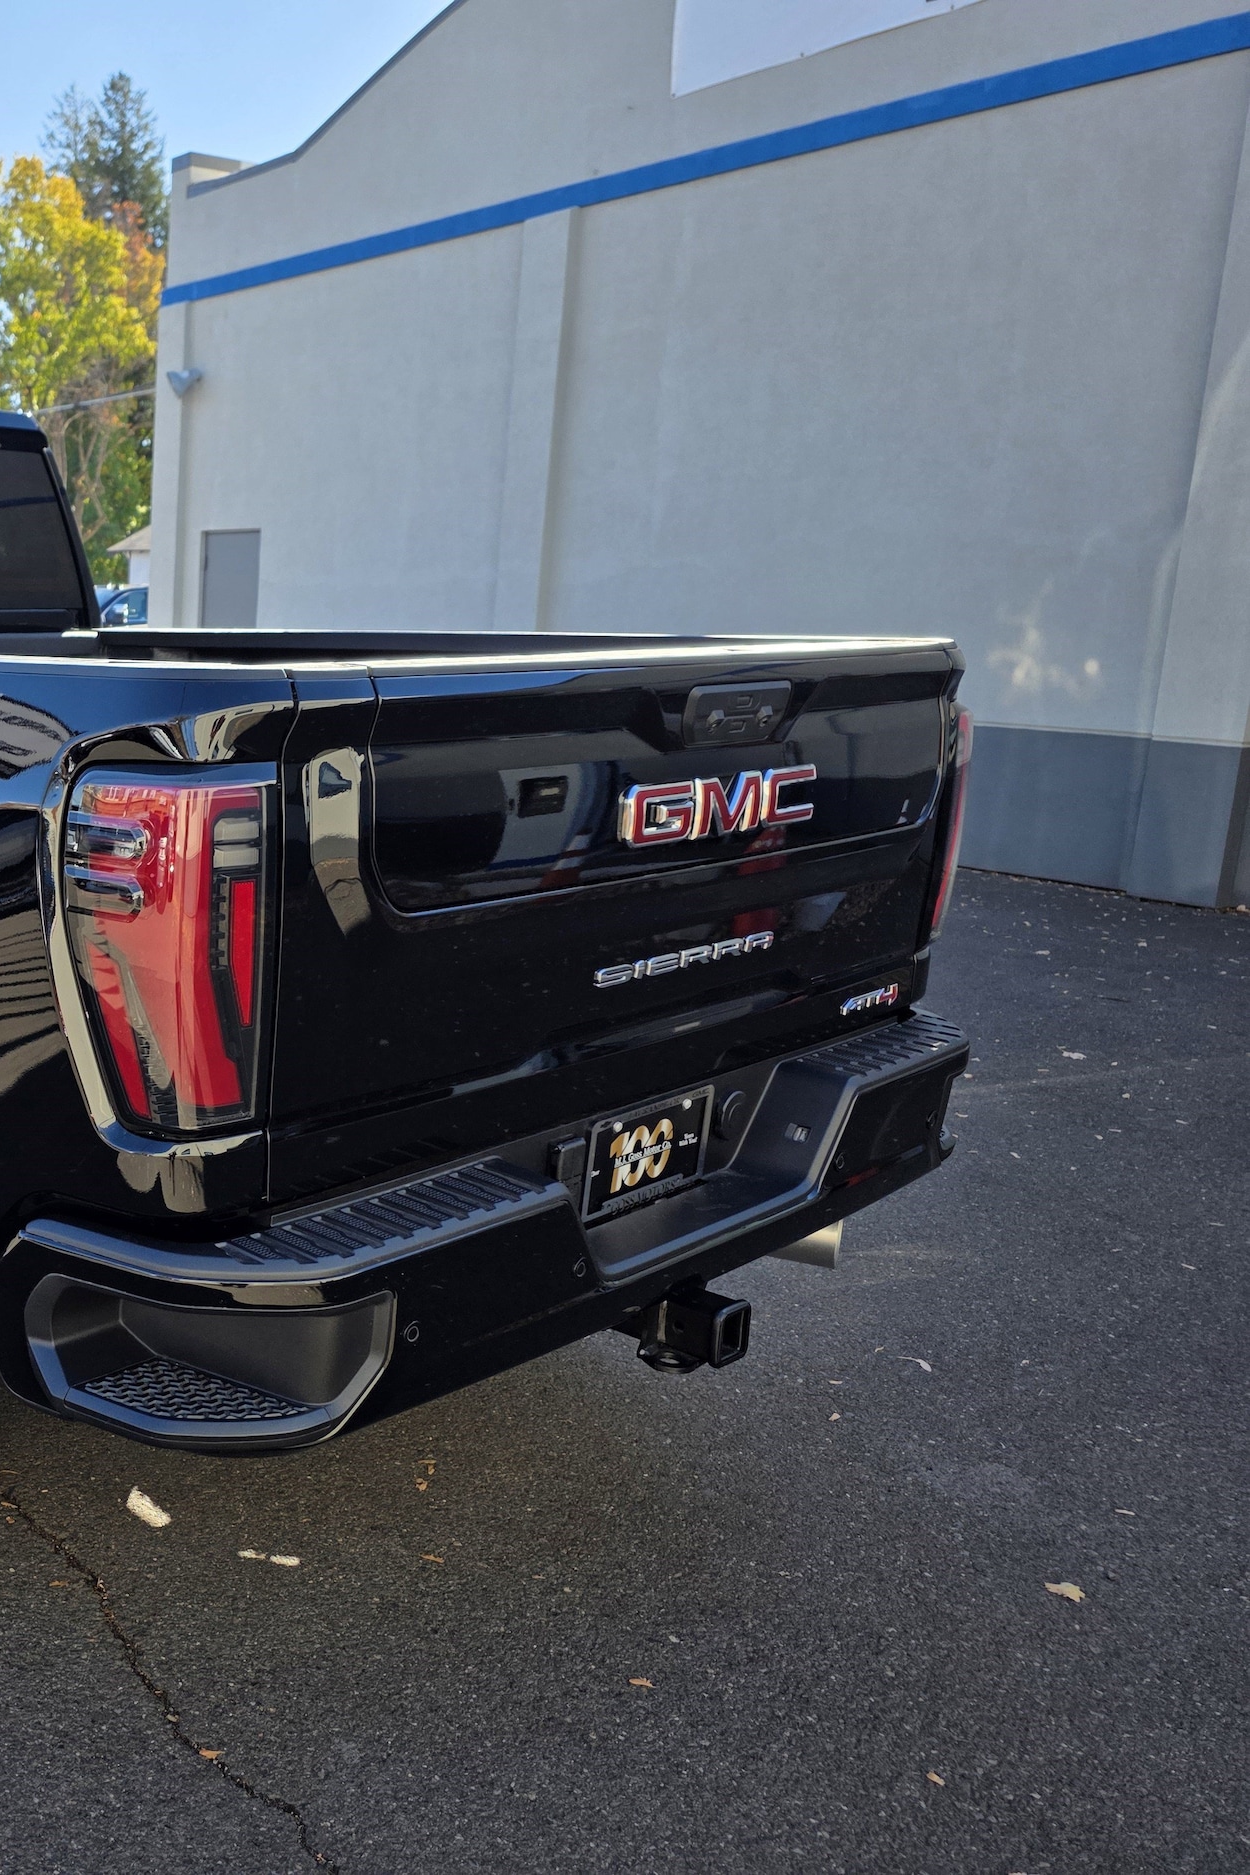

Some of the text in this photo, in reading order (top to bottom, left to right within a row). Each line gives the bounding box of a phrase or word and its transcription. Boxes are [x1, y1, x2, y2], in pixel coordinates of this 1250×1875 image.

[617, 763, 817, 848] GMC
[593, 931, 775, 988] SIERRA
[840, 983, 899, 1015] AT4
[610, 1118, 674, 1194] 100
